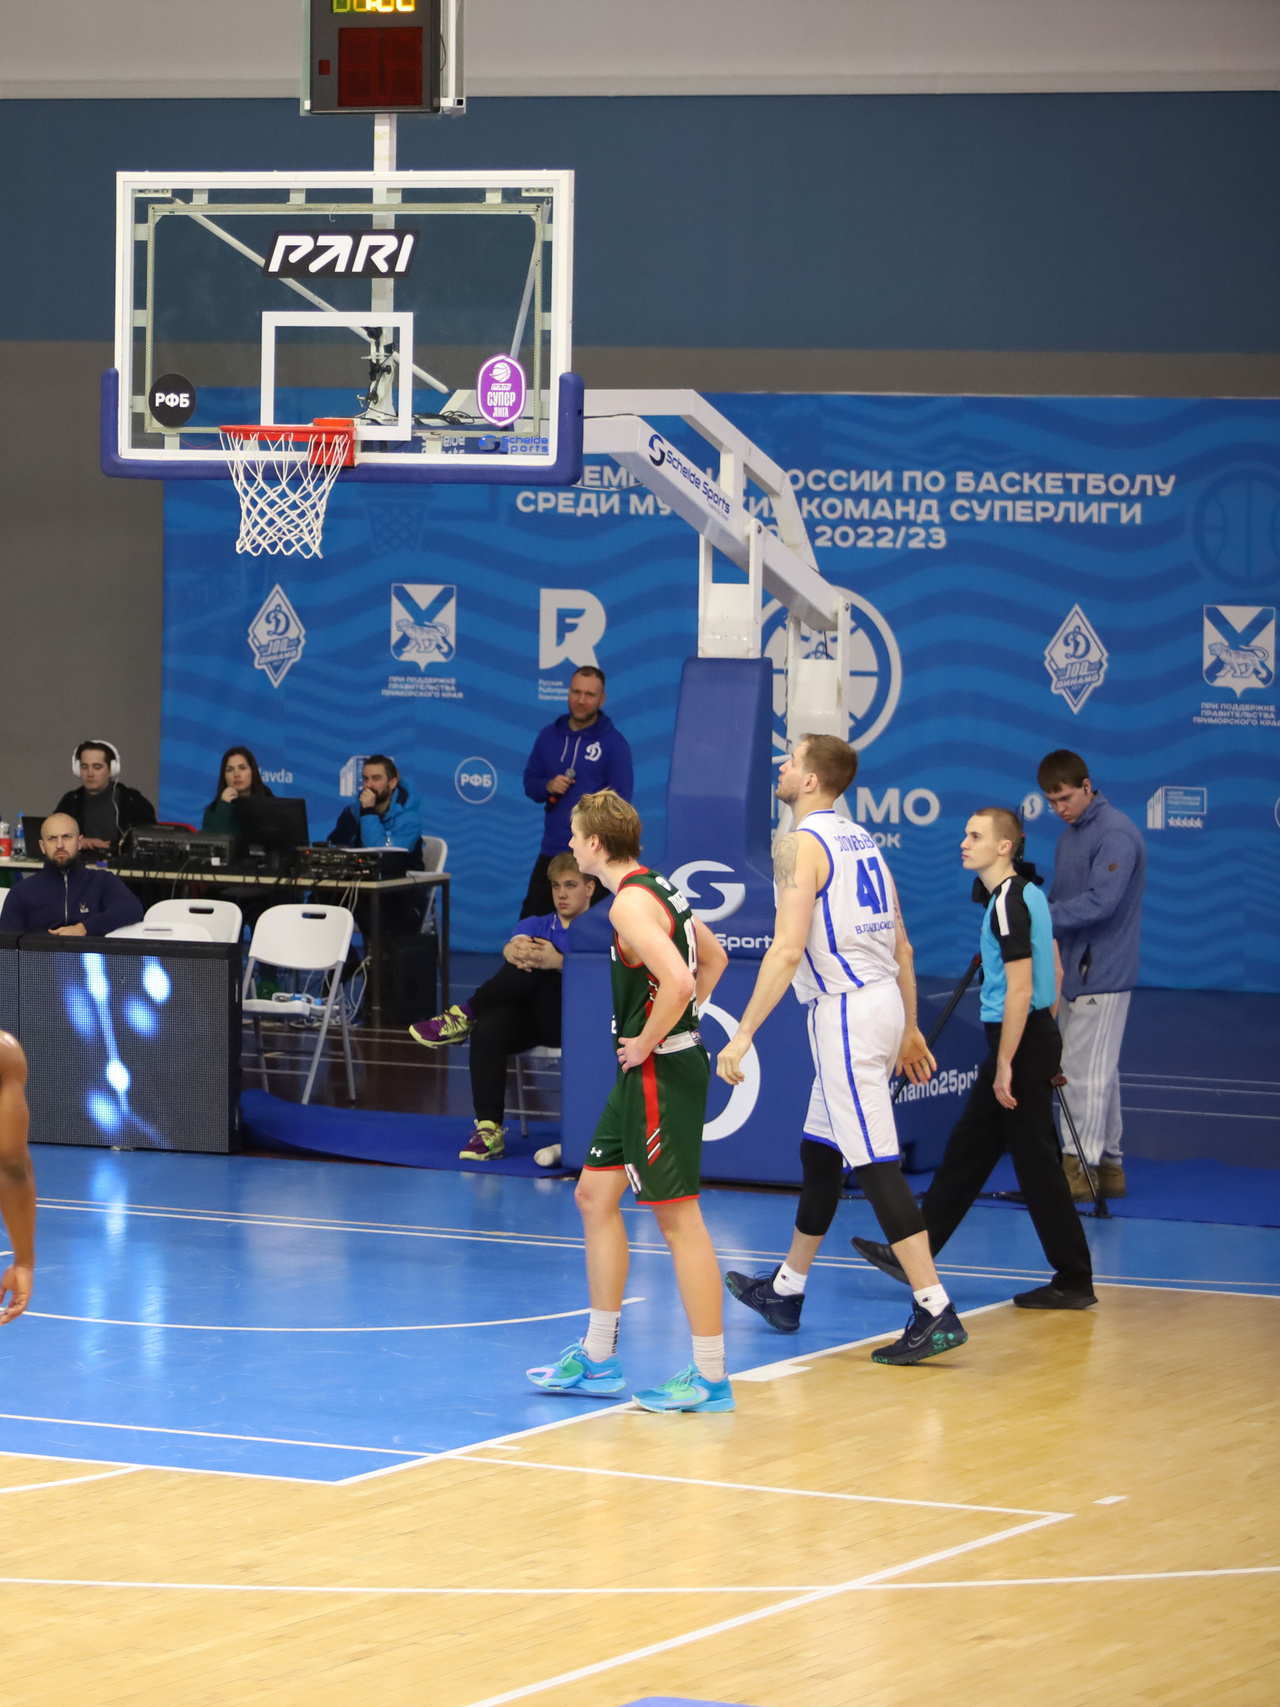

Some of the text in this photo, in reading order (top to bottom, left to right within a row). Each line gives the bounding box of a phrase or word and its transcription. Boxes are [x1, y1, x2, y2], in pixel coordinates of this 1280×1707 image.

[268, 234, 415, 273] PARI
[155, 392, 190, 408] РФБ
[486, 391, 516, 407] СУПЕР
[786, 469, 1176, 497] ОССИИ ПО БАСКЕТБОЛУ
[516, 491, 620, 518] СРЕДИ
[702, 481, 730, 514] Sports
[801, 497, 940, 523] КОМАНД
[949, 500, 1142, 525] СУПЕРЛИГИ
[814, 525, 947, 550] 2022/23
[460, 773, 493, 788] РФБ
[714, 933, 775, 951] Sport
